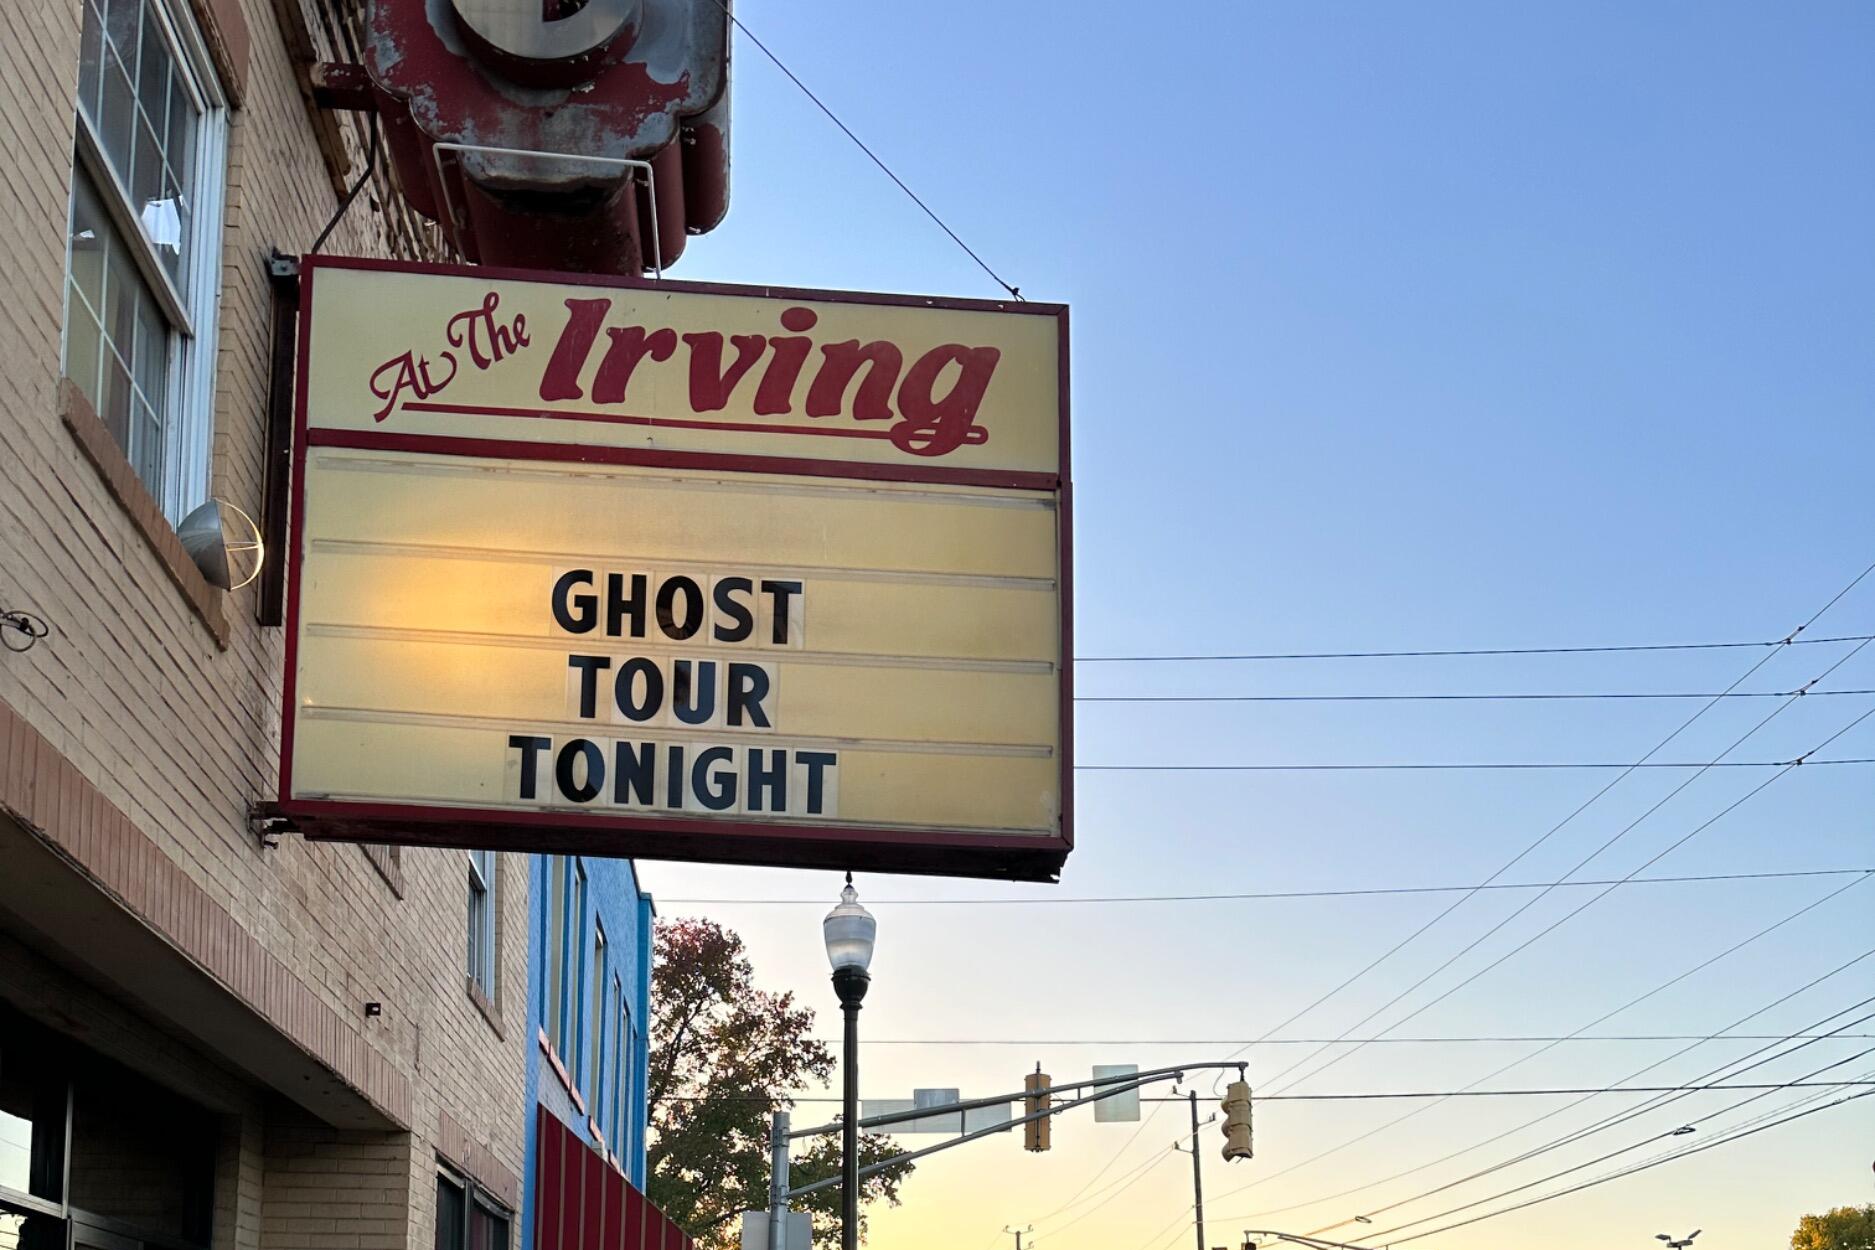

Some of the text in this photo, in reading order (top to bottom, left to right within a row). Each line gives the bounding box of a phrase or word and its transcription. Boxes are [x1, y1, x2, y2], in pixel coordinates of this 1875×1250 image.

[369, 292, 1001, 457] At The Irving
[552, 569, 802, 645] GHOST
[569, 654, 771, 728] TOUR
[508, 735, 838, 815] TONIGHT
